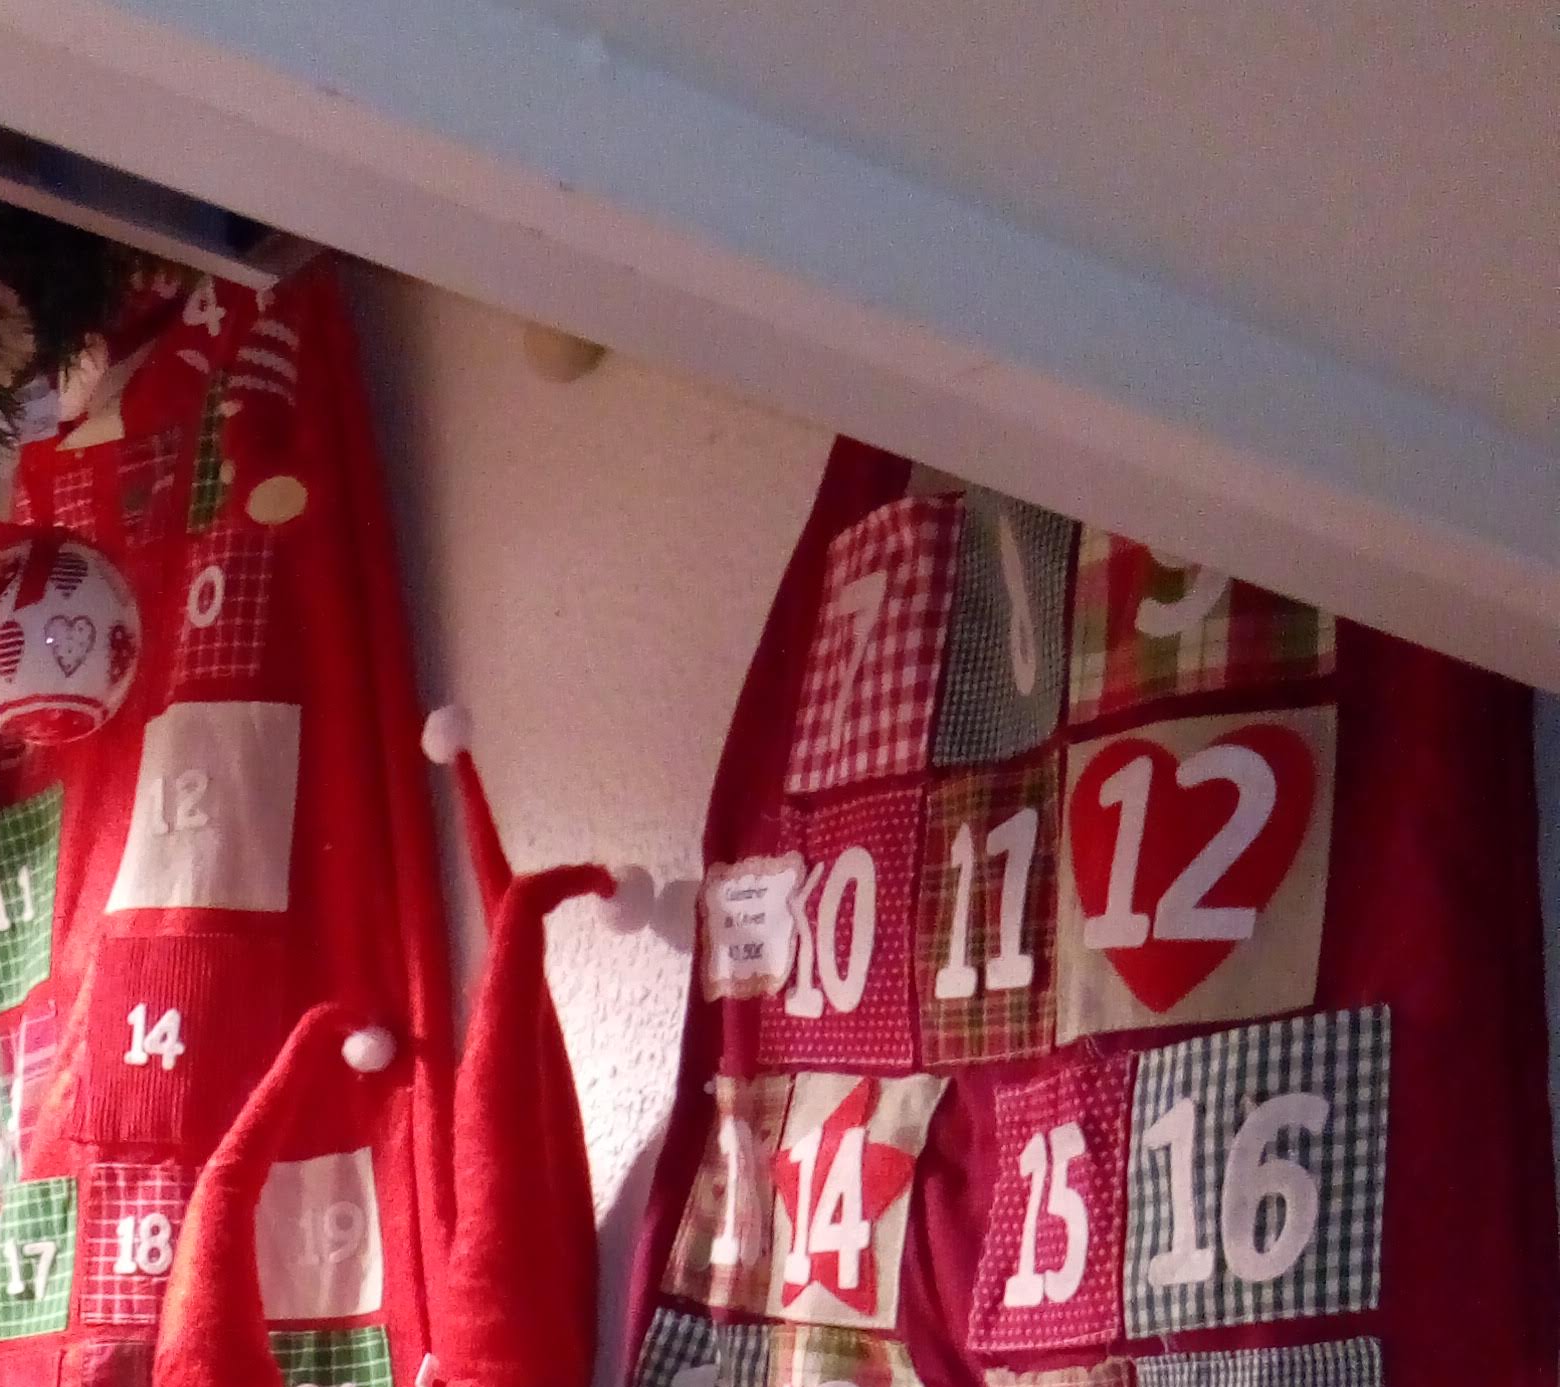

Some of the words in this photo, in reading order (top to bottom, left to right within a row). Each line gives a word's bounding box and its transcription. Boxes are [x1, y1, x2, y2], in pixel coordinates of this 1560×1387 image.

[148, 769, 212, 834] 12
[1083, 743, 1276, 949] 12
[935, 807, 1039, 999] 11
[123, 1003, 186, 1070] 14
[116, 1212, 173, 1276] 18
[299, 1201, 367, 1267] 19
[784, 1126, 871, 1289] 14
[1004, 1121, 1090, 1307] 15
[1142, 1093, 1330, 1285] 16
[3, 1240, 58, 1302] 17
